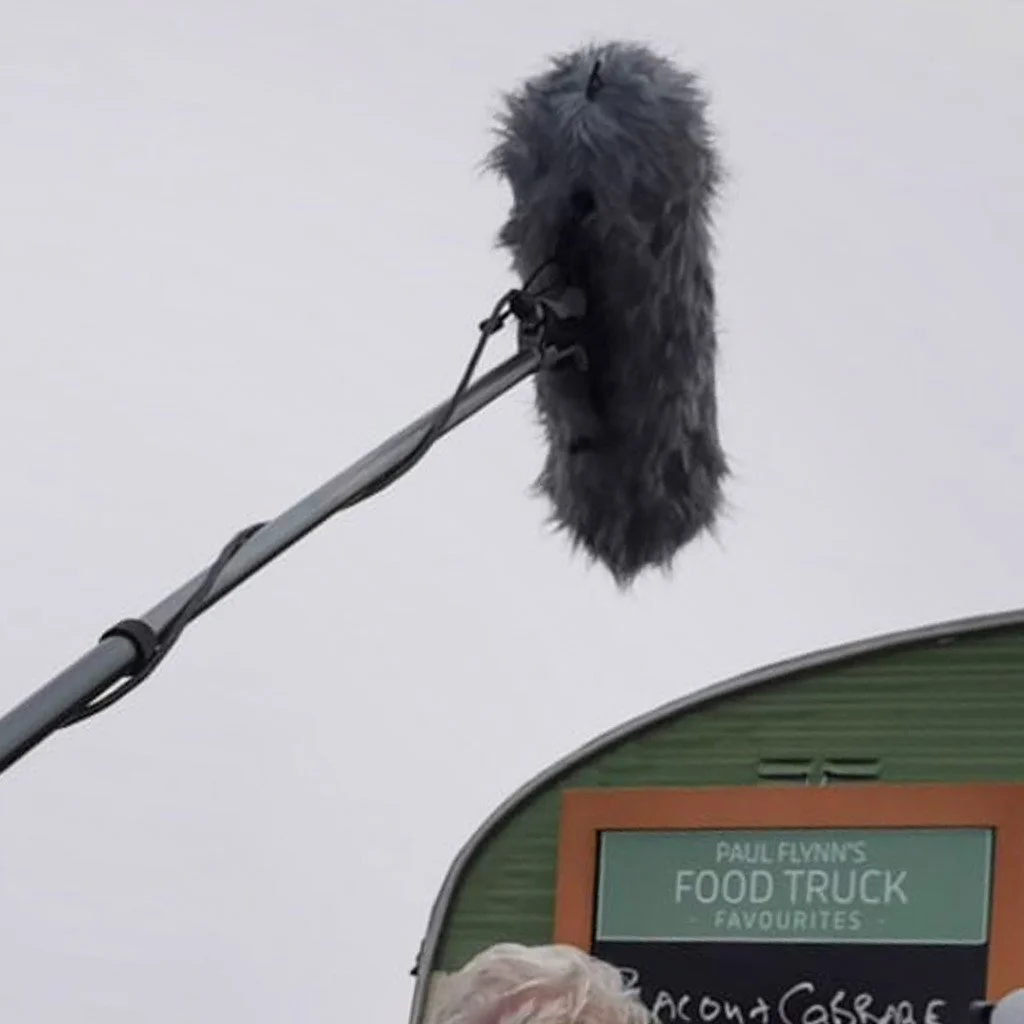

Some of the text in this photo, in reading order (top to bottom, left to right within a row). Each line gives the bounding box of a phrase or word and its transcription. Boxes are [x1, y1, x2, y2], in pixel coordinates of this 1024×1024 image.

[716, 840, 867, 864] PAUL FLYNN'S
[675, 868, 909, 905] FOOD TRUCK
[714, 909, 863, 931] FAVOURITES
